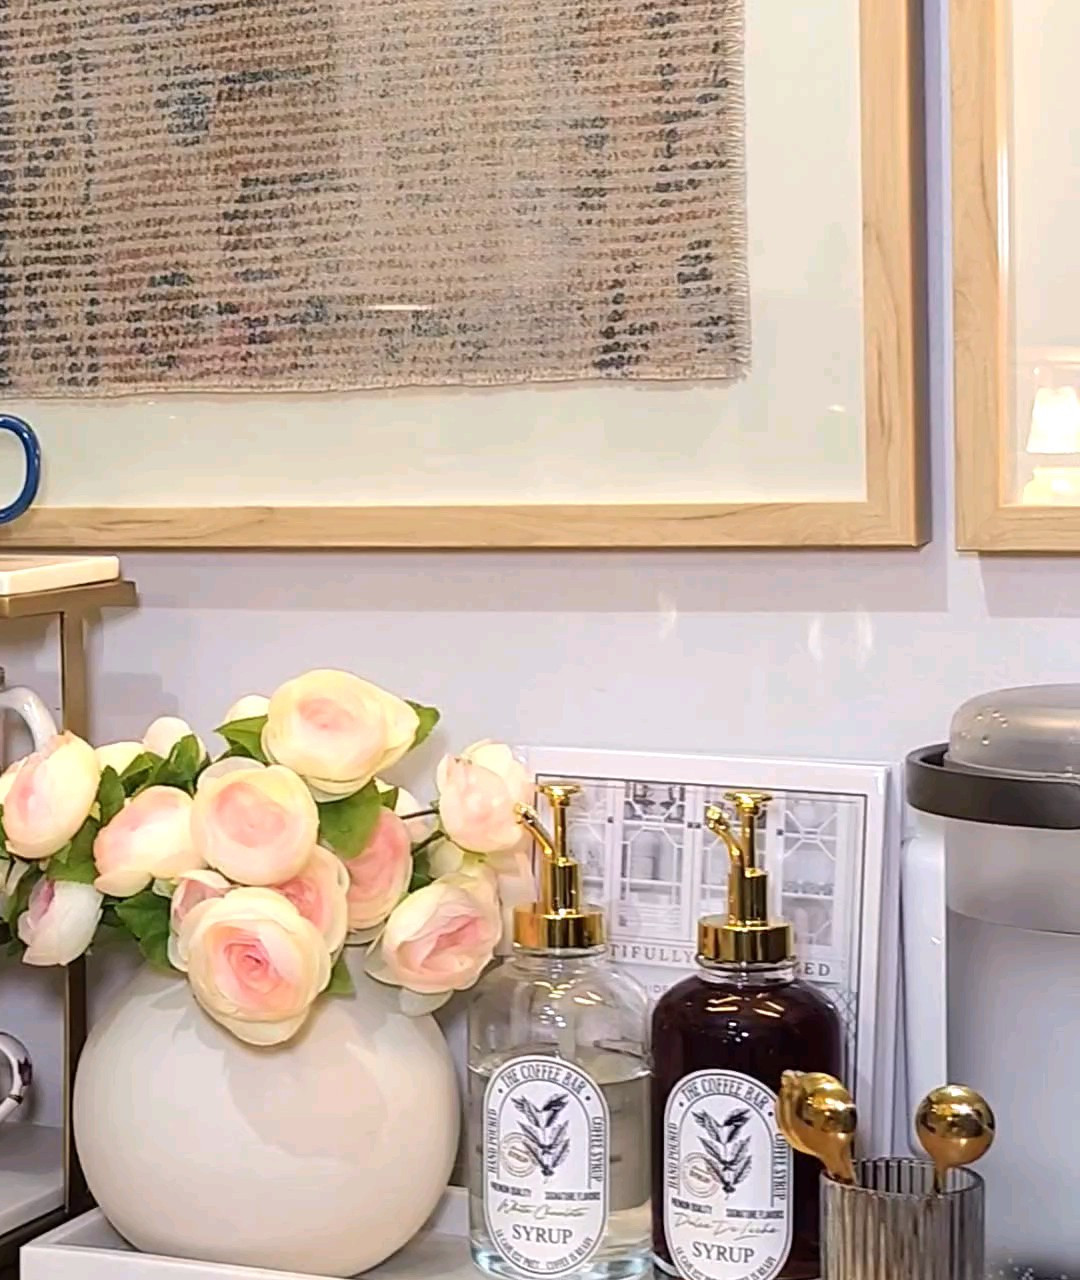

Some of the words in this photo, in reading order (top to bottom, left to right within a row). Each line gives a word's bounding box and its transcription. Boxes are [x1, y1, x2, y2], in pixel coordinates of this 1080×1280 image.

[609, 943, 695, 964] TIFULLY
[500, 1068, 521, 1089] THE
[520, 1064, 563, 1081] COFFEE
[561, 1071, 587, 1095] BAR
[682, 1081, 701, 1102] THE
[701, 1078, 744, 1096] COFFEE
[743, 1086, 770, 1111] BAR
[511, 1223, 573, 1245] SYRUP
[692, 1240, 755, 1264] SYRUP
